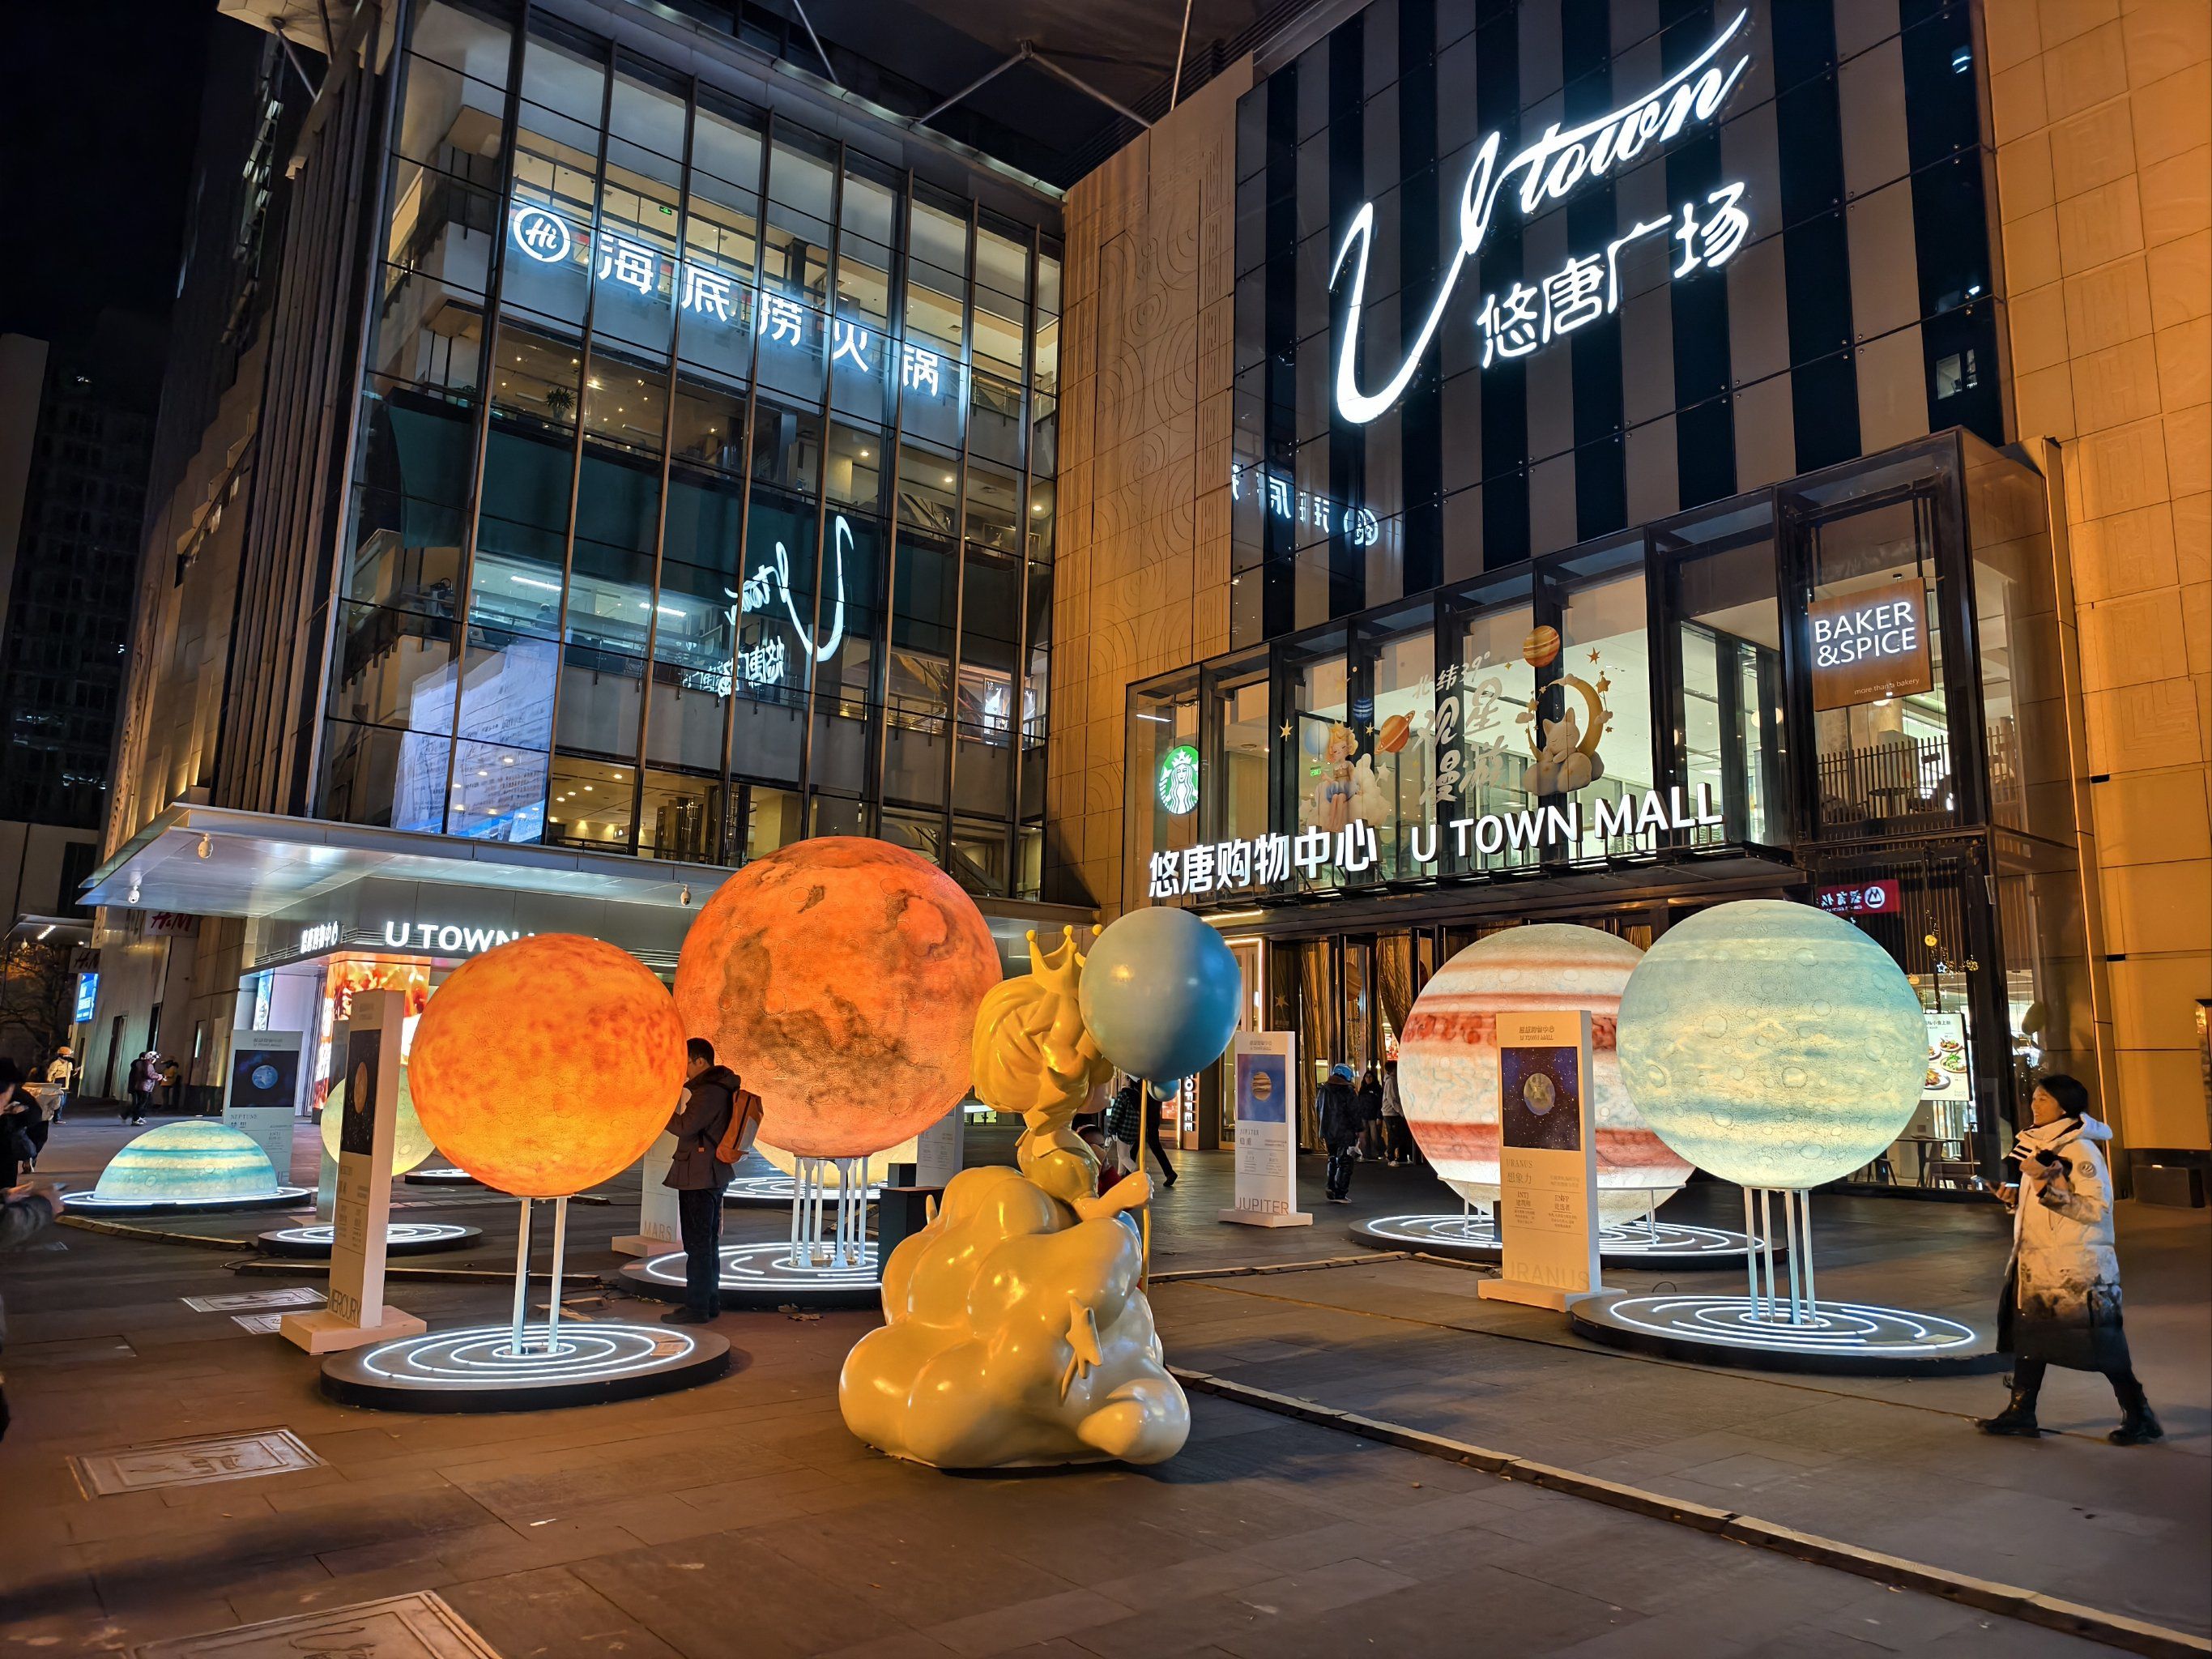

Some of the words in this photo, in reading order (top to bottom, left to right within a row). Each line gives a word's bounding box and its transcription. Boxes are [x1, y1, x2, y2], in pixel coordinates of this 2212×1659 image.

[526, 215, 558, 249] Hi
[1477, 181, 1749, 369] 悠唐广场
[599, 230, 939, 397] 海底捞火锅
[1814, 601, 1915, 643] BAKER
[1817, 626, 1917, 667] &SPICE
[1854, 687, 1873, 695] more
[1873, 682, 1890, 692] than
[1896, 677, 1920, 689] bakery
[1149, 819, 1378, 898] 悠唐购物中心
[1411, 825, 1438, 863] U
[1449, 802, 1583, 859] TOWN
[1594, 783, 1724, 839] MALL
[385, 921, 411, 947] U
[417, 923, 519, 953] TOWN
[1184, 1074, 1194, 1132] OFFEE
[1506, 1158, 1534, 1169] URANUS
[1236, 1197, 1289, 1215] JUPITER
[644, 1220, 672, 1240] MARS
[1503, 1260, 1590, 1291] URANUS
